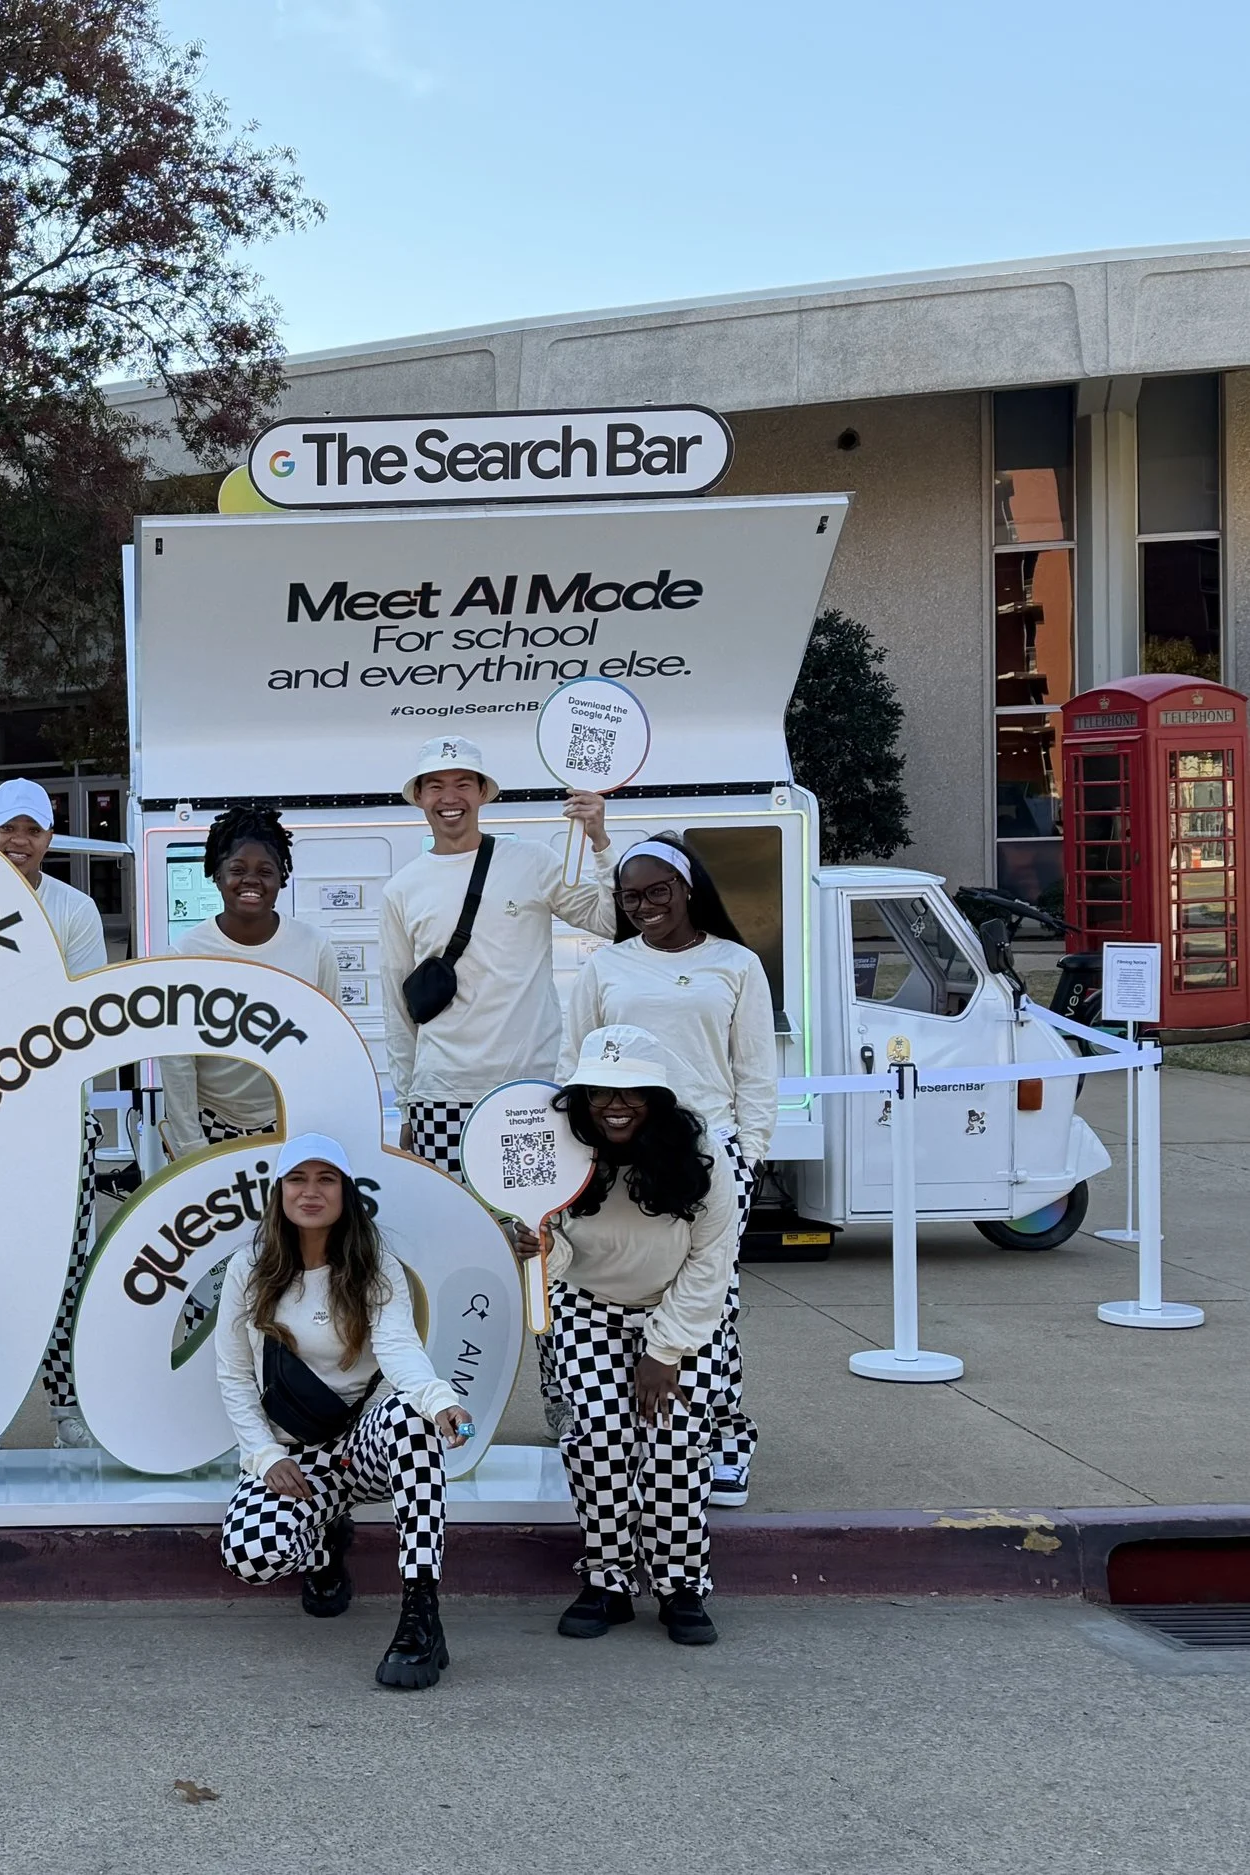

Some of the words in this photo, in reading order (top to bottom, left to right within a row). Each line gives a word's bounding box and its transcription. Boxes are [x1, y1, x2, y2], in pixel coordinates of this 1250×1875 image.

[269, 450, 295, 478] G
[302, 432, 408, 486] The
[414, 424, 598, 483] Search
[606, 422, 702, 477] Bar
[287, 581, 441, 623] Meet
[450, 574, 518, 616] AI
[525, 569, 704, 614] Mode
[373, 624, 443, 653] For
[452, 618, 599, 650] school
[267, 661, 350, 690] and
[359, 653, 588, 691] everything
[598, 650, 692, 679] else.
[390, 700, 543, 717] #GoogleSearchB
[568, 696, 612, 712] Download
[613, 706, 628, 715] the
[571, 706, 603, 720] Google
[604, 713, 623, 724] App
[1077, 713, 1138, 727] TELEPHONE
[1162, 709, 1232, 723] TELEPHONE
[1065, 984, 1083, 1016] veo
[505, 1109, 528, 1117] Share
[529, 1107, 548, 1117] your
[509, 1116, 545, 1126] thoughts
[123, 1160, 382, 1306] questis
